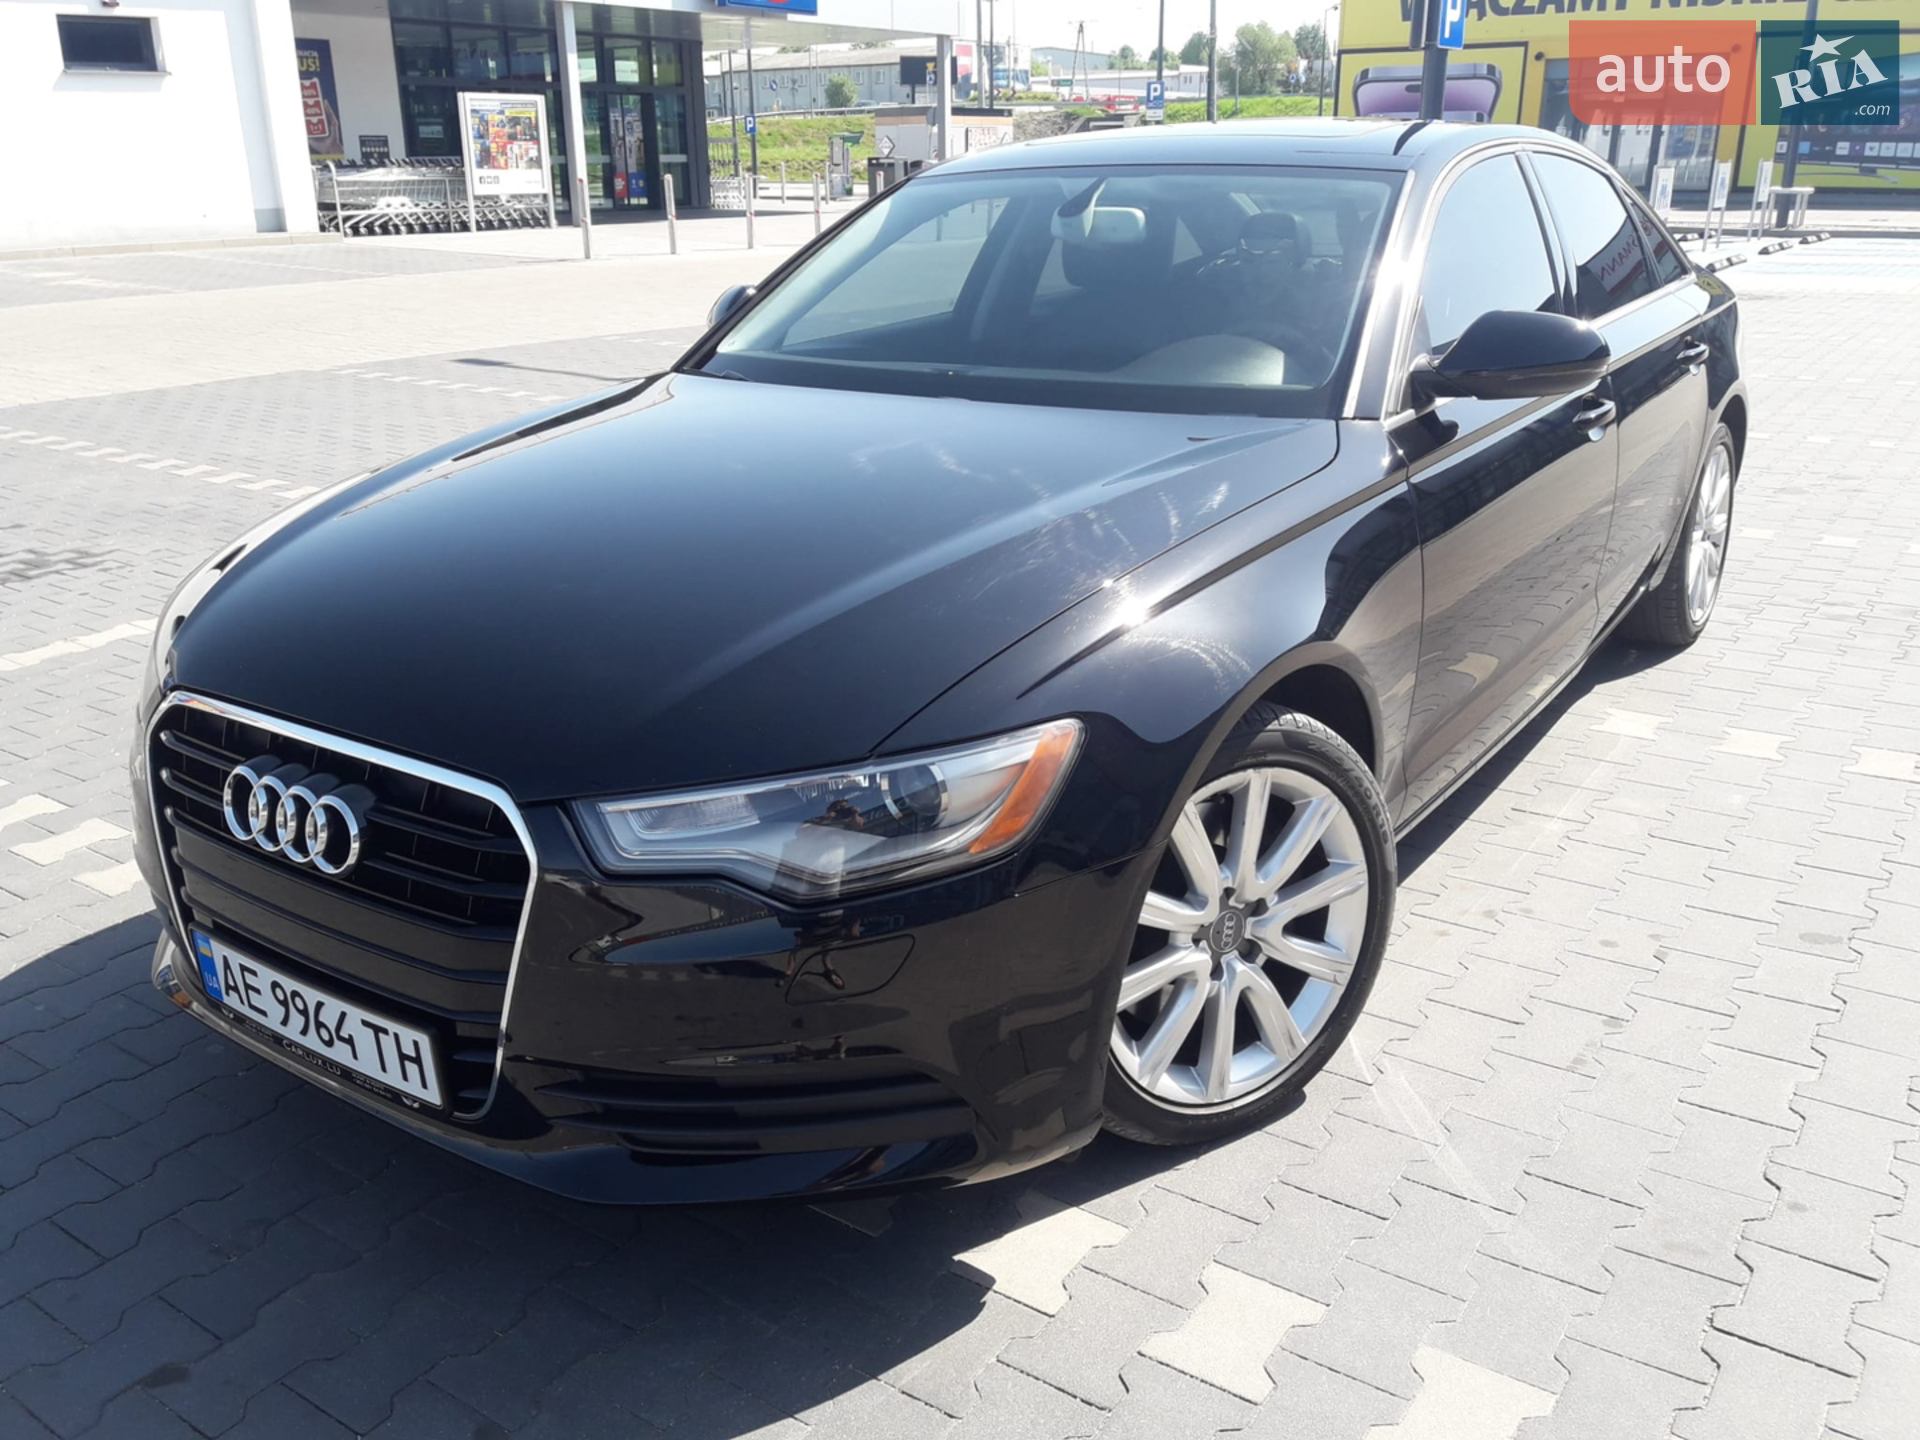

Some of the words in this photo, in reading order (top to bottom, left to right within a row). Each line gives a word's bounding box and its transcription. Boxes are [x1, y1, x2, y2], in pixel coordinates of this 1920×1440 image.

[1150, 84, 1161, 101] P
[746, 117, 754, 131] P
[205, 972, 220, 989] UA
[222, 954, 268, 1018] AE
[270, 980, 359, 1061] 9964
[360, 1018, 428, 1090] TH
[282, 1039, 341, 1076] CARLUX.LU
